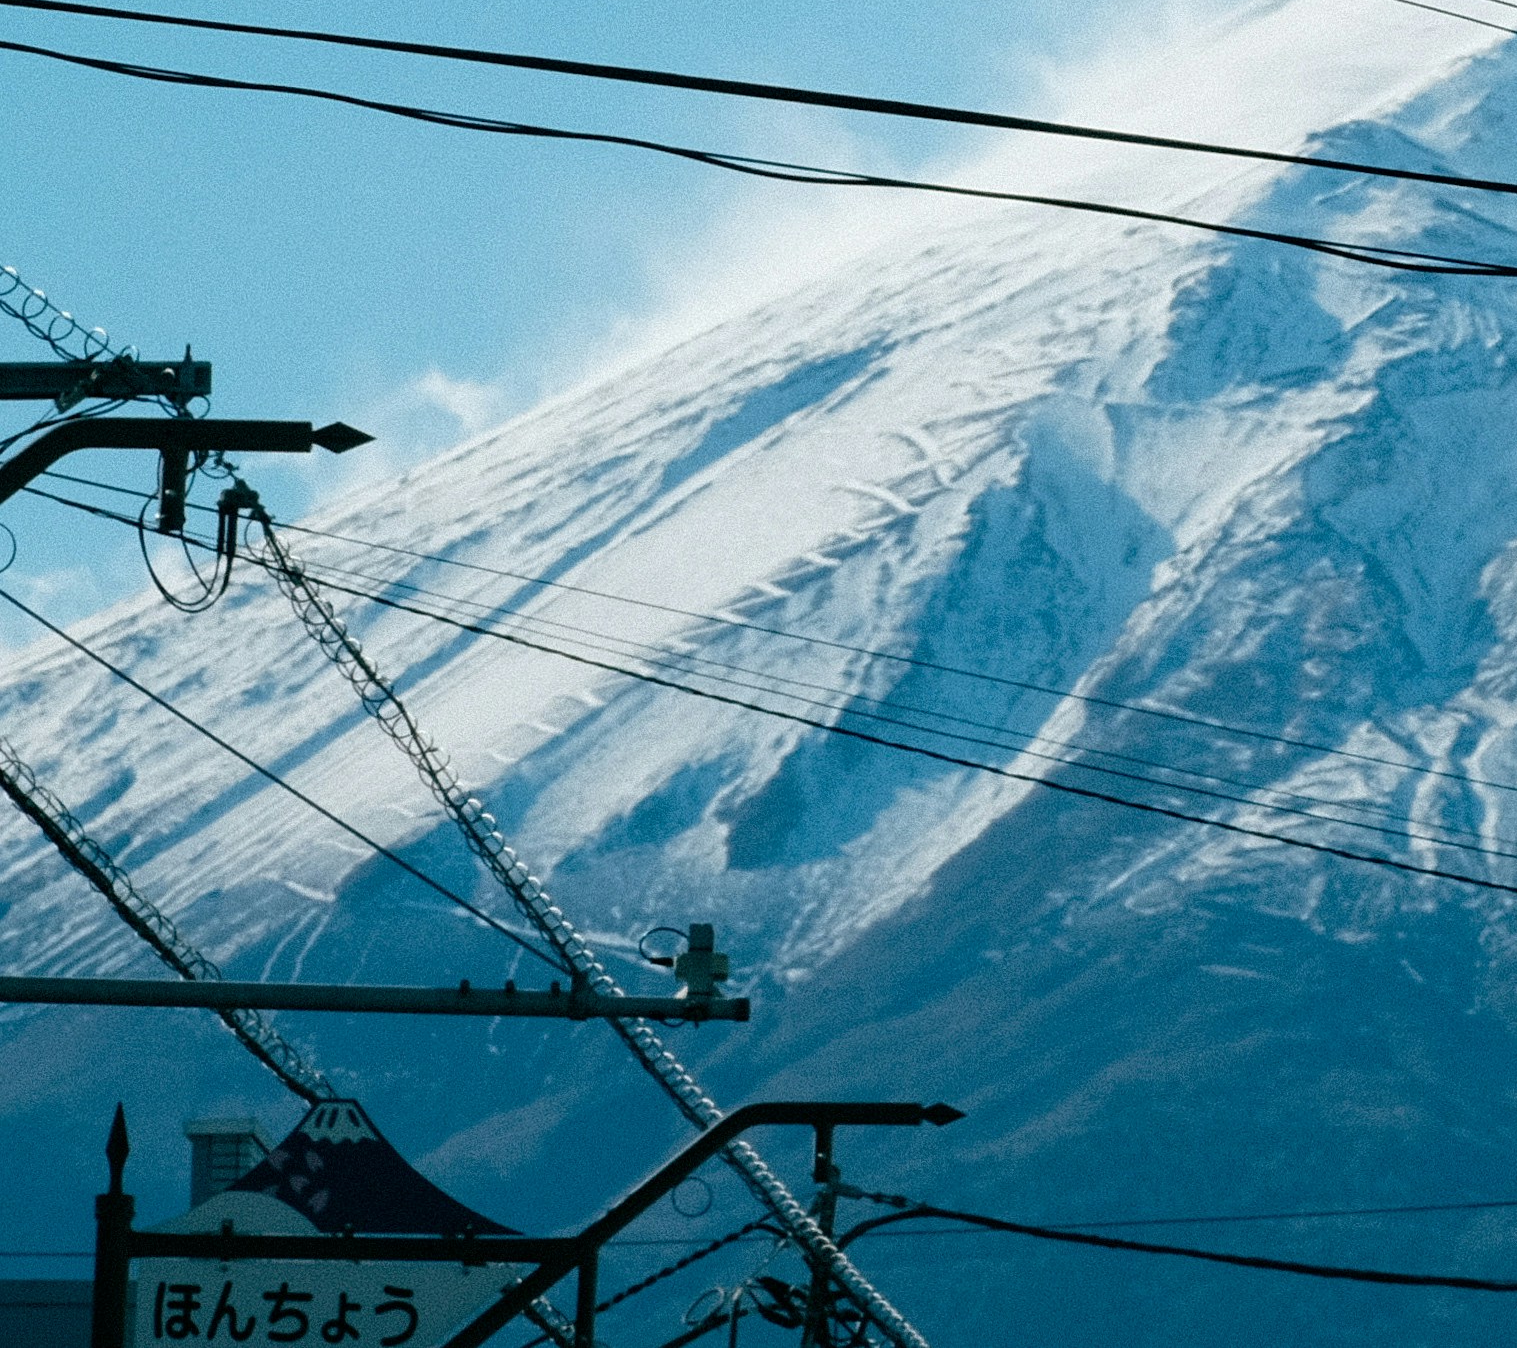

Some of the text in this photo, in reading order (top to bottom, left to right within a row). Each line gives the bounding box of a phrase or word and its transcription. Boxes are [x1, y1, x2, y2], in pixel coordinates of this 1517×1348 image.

[153, 1281, 419, 1346] ほんちょう
